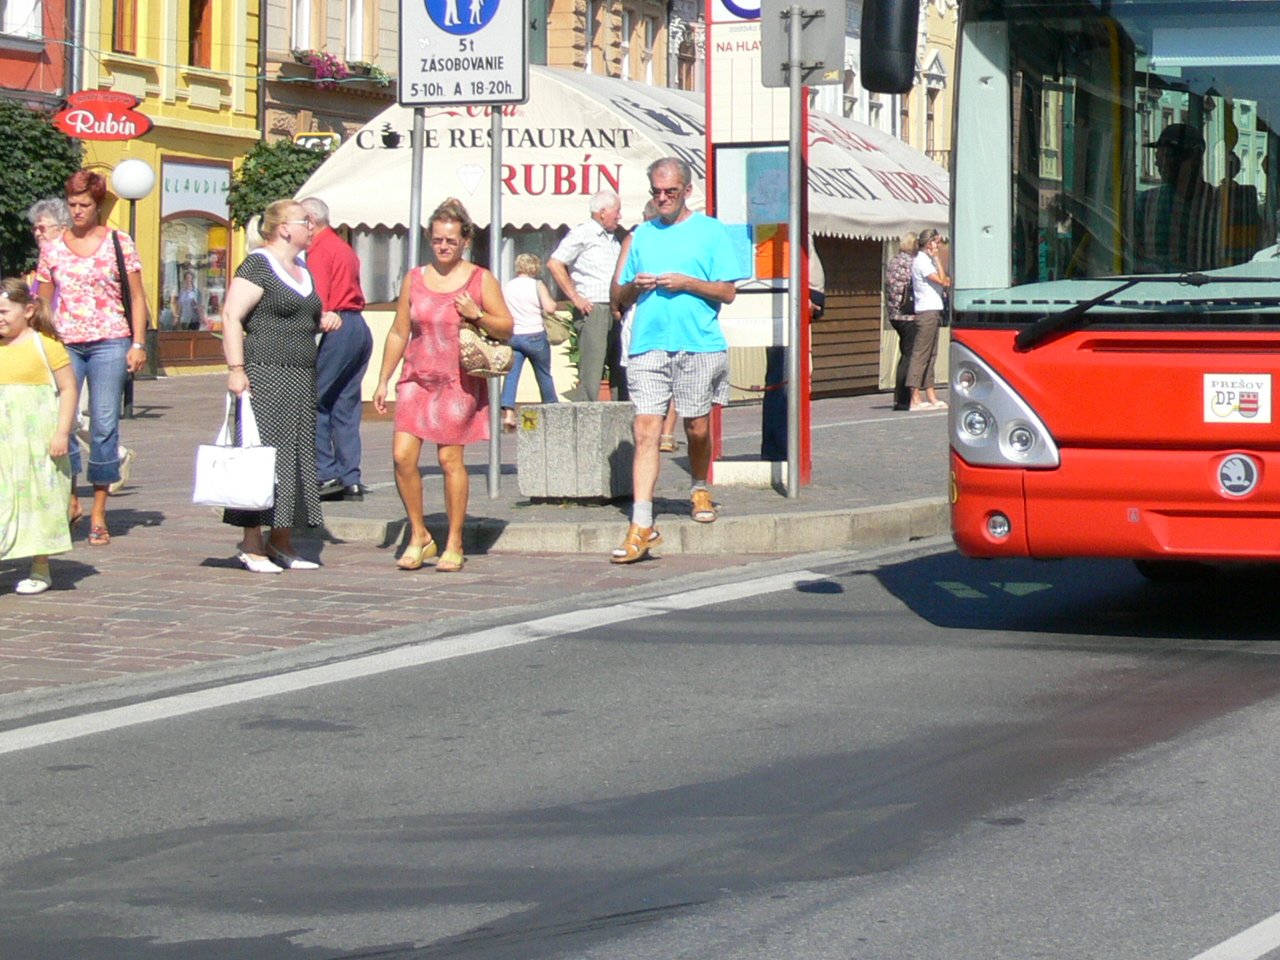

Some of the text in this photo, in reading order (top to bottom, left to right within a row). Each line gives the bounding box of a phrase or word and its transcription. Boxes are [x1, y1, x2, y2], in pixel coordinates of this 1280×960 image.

[716, 42, 733, 52] NA
[421, 54, 504, 72] ZÁSOBOVANIE
[454, 82, 462, 96] A
[66, 110, 136, 136] Rubín
[500, 154, 623, 196] RUBÍN
[165, 176, 229, 194] KLAUDIA
[1211, 379, 1264, 390] PREŠOV
[1215, 391, 1236, 405] DP
